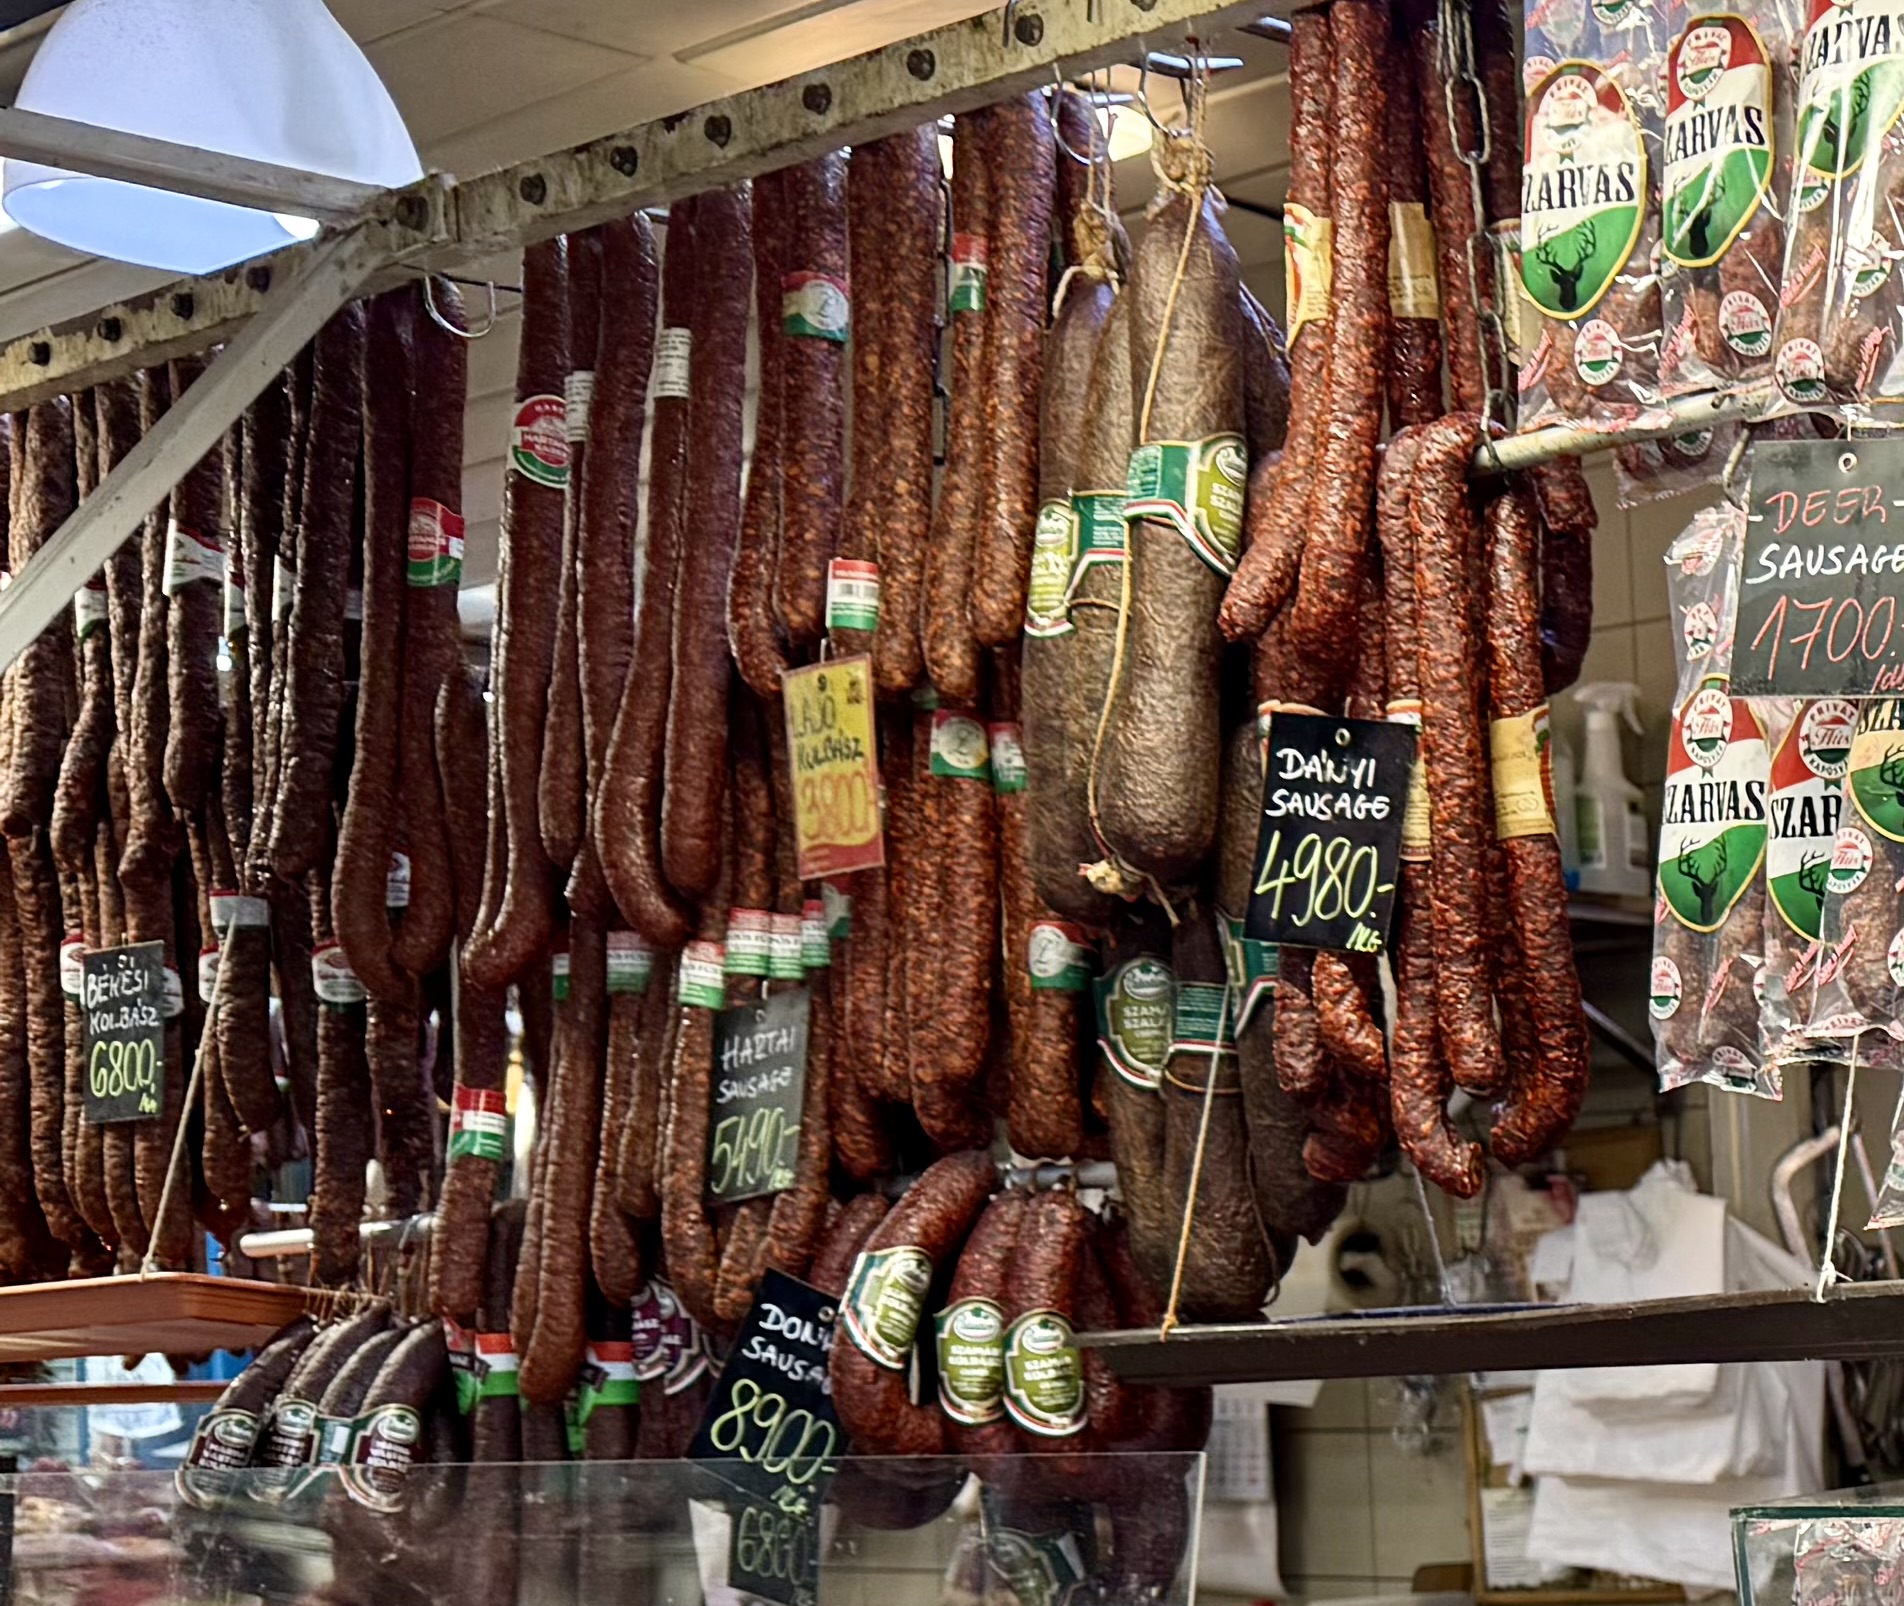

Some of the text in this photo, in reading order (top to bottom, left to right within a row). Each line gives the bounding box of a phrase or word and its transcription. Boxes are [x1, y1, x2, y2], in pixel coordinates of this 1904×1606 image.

[1522, 161, 1635, 213] ZARVAS
[1765, 485, 1888, 534] DEER
[1264, 787, 1391, 820] SAUSAGE
[1770, 794, 1841, 841] SZAR
[716, 1066, 793, 1104] SAUSAGE
